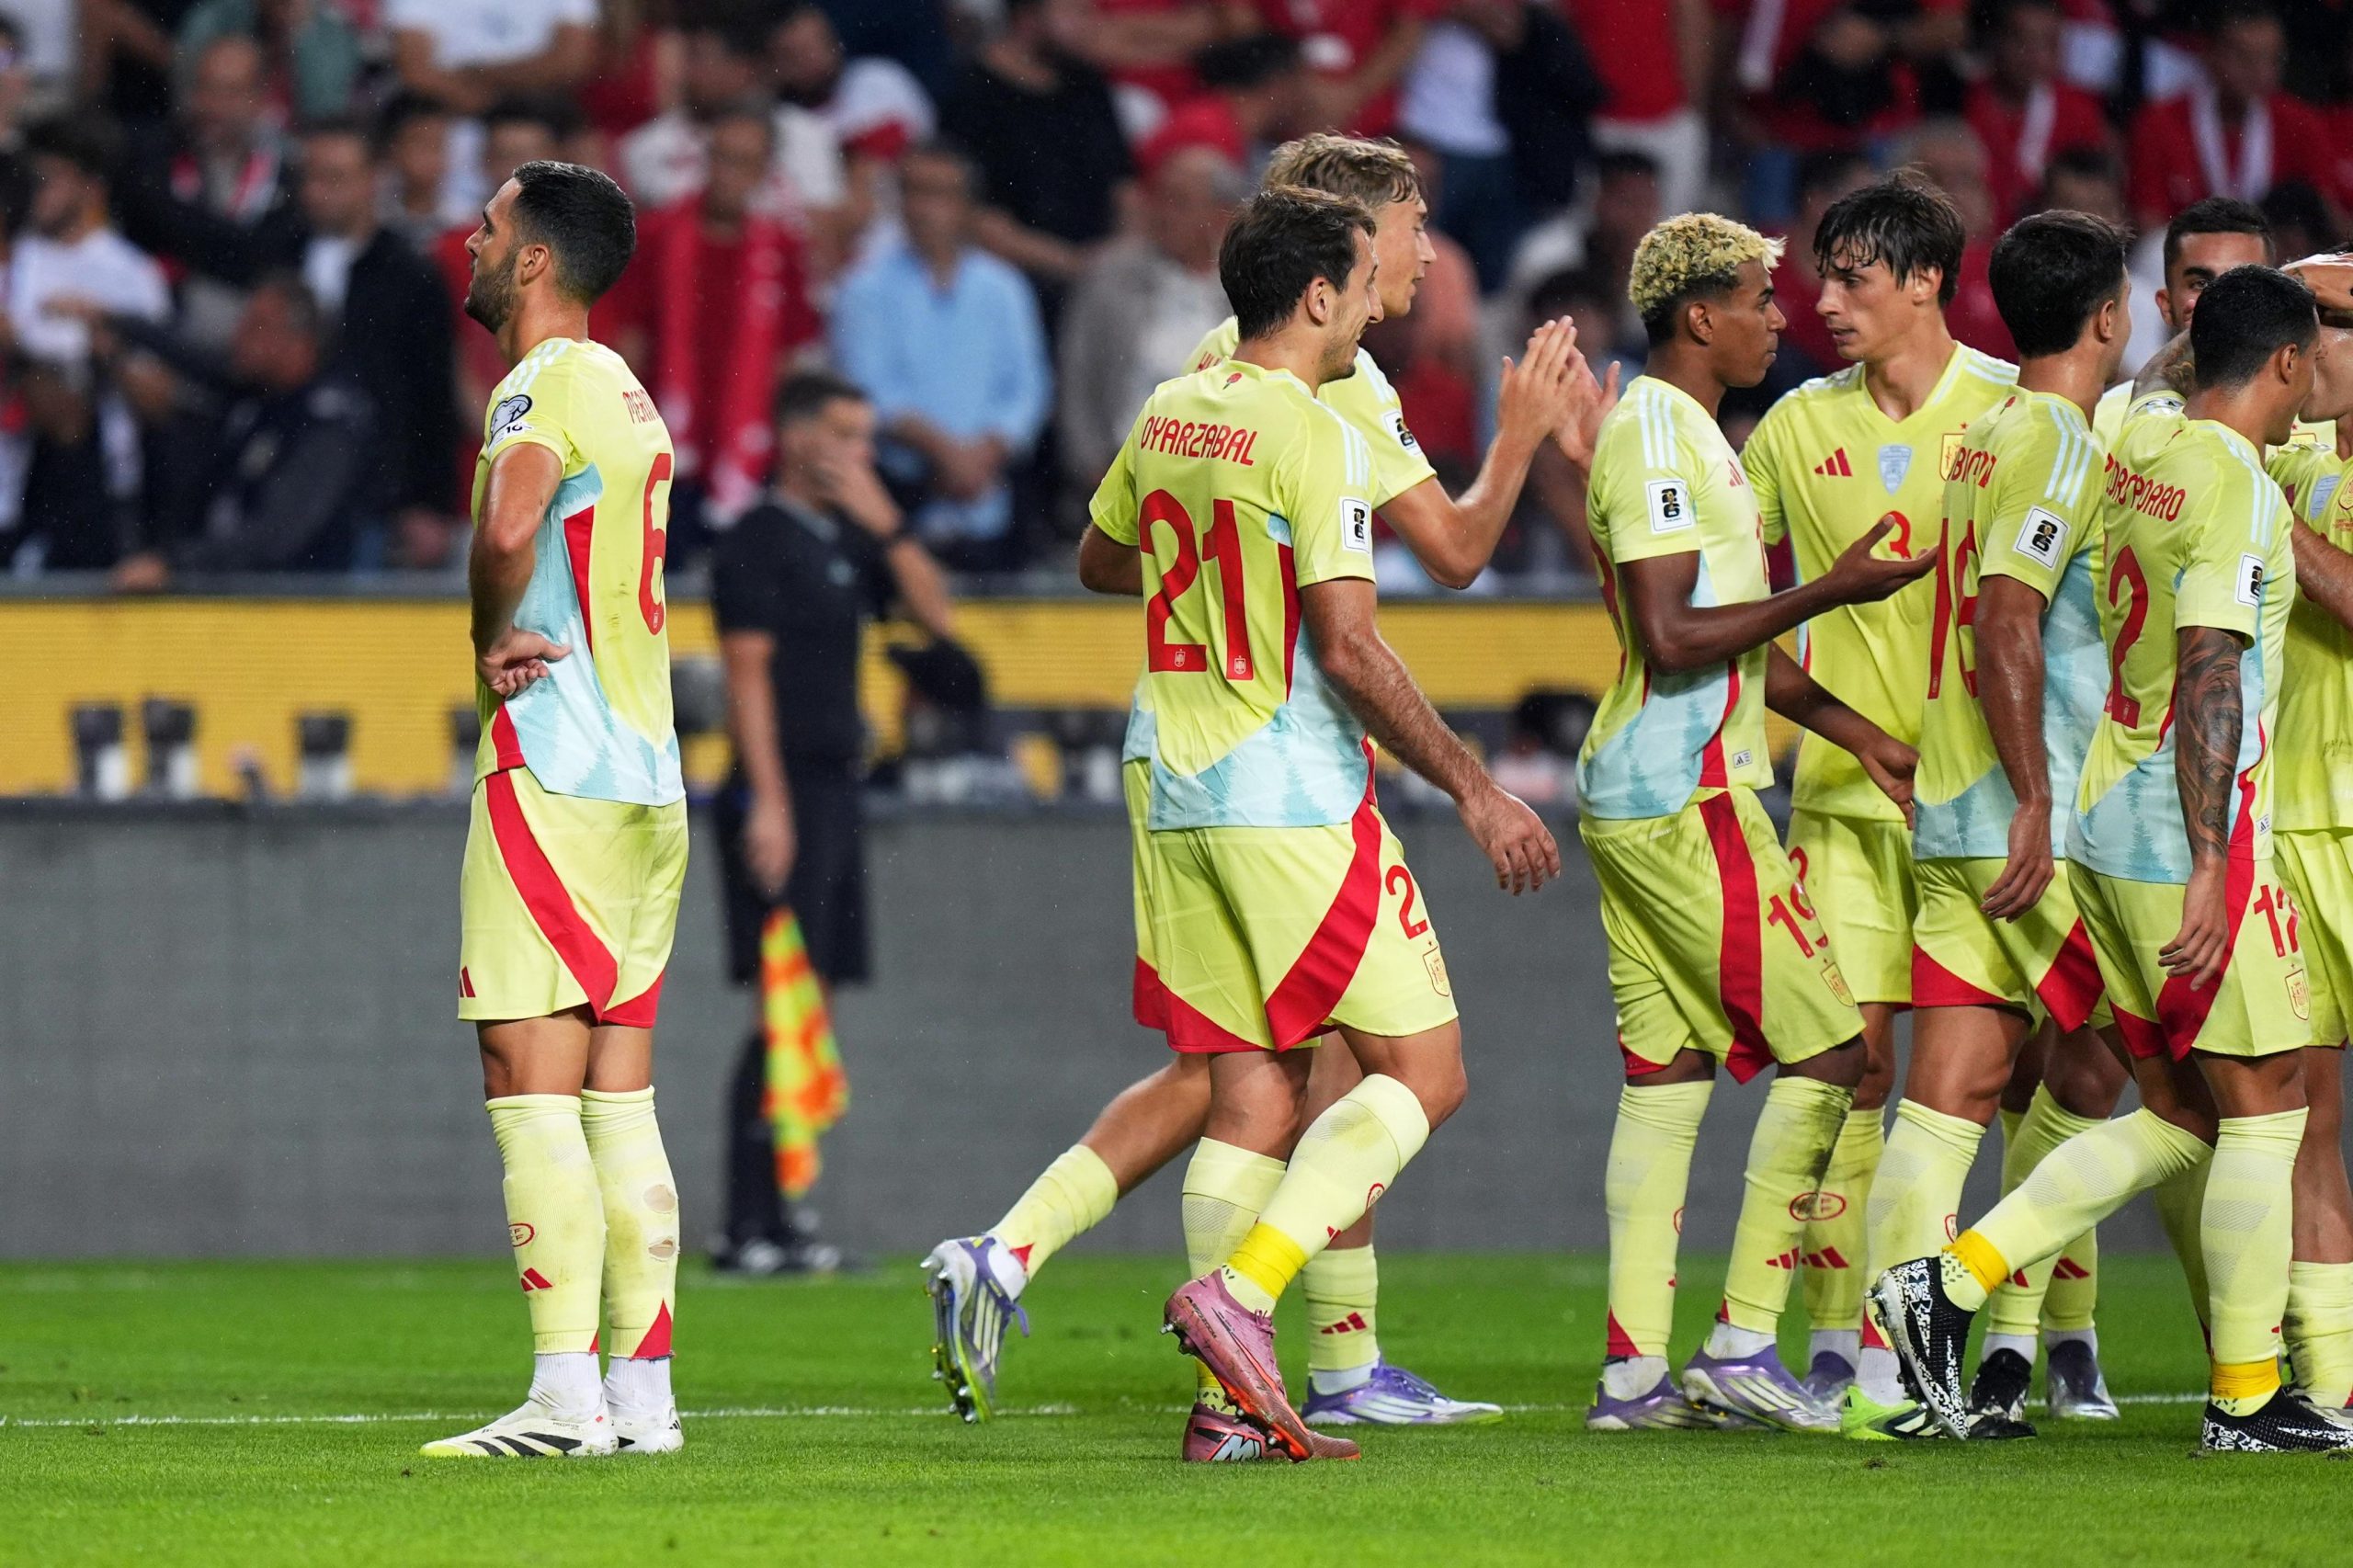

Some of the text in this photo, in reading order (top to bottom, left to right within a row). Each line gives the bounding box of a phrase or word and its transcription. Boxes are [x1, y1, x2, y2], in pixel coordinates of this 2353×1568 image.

[1140, 414, 1258, 467] OYARZABAL
[639, 452, 672, 636] 6
[1138, 488, 1254, 681] 21
[2103, 530, 2149, 730] 2
[1385, 864, 1428, 939] 2
